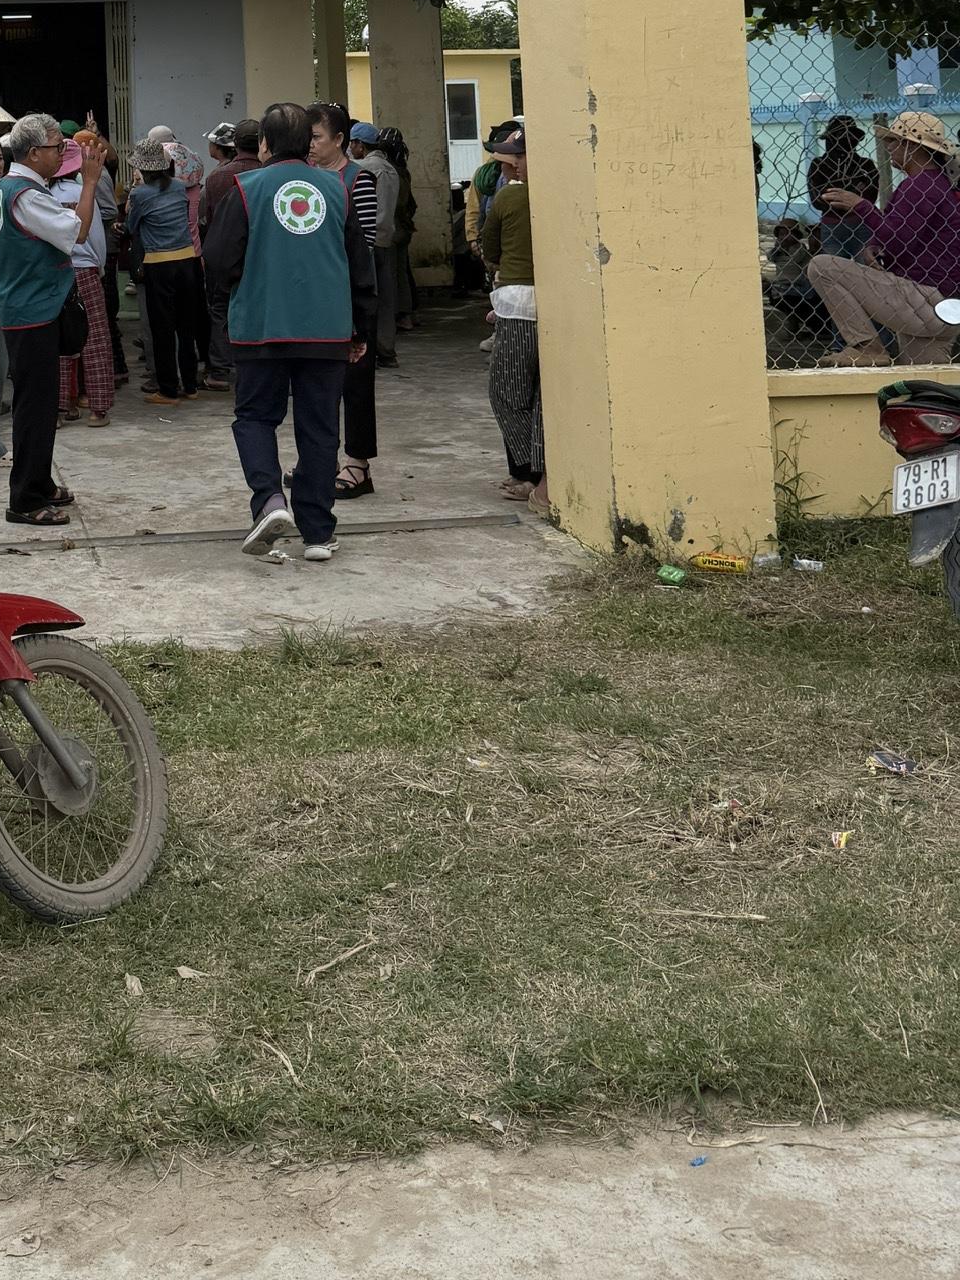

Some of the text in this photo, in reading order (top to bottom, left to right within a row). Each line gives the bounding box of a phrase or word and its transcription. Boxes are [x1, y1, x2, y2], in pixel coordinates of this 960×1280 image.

[903, 457, 947, 487] 79-R1
[902, 480, 949, 508] 3603
[702, 558, 737, 568] BONCHA
